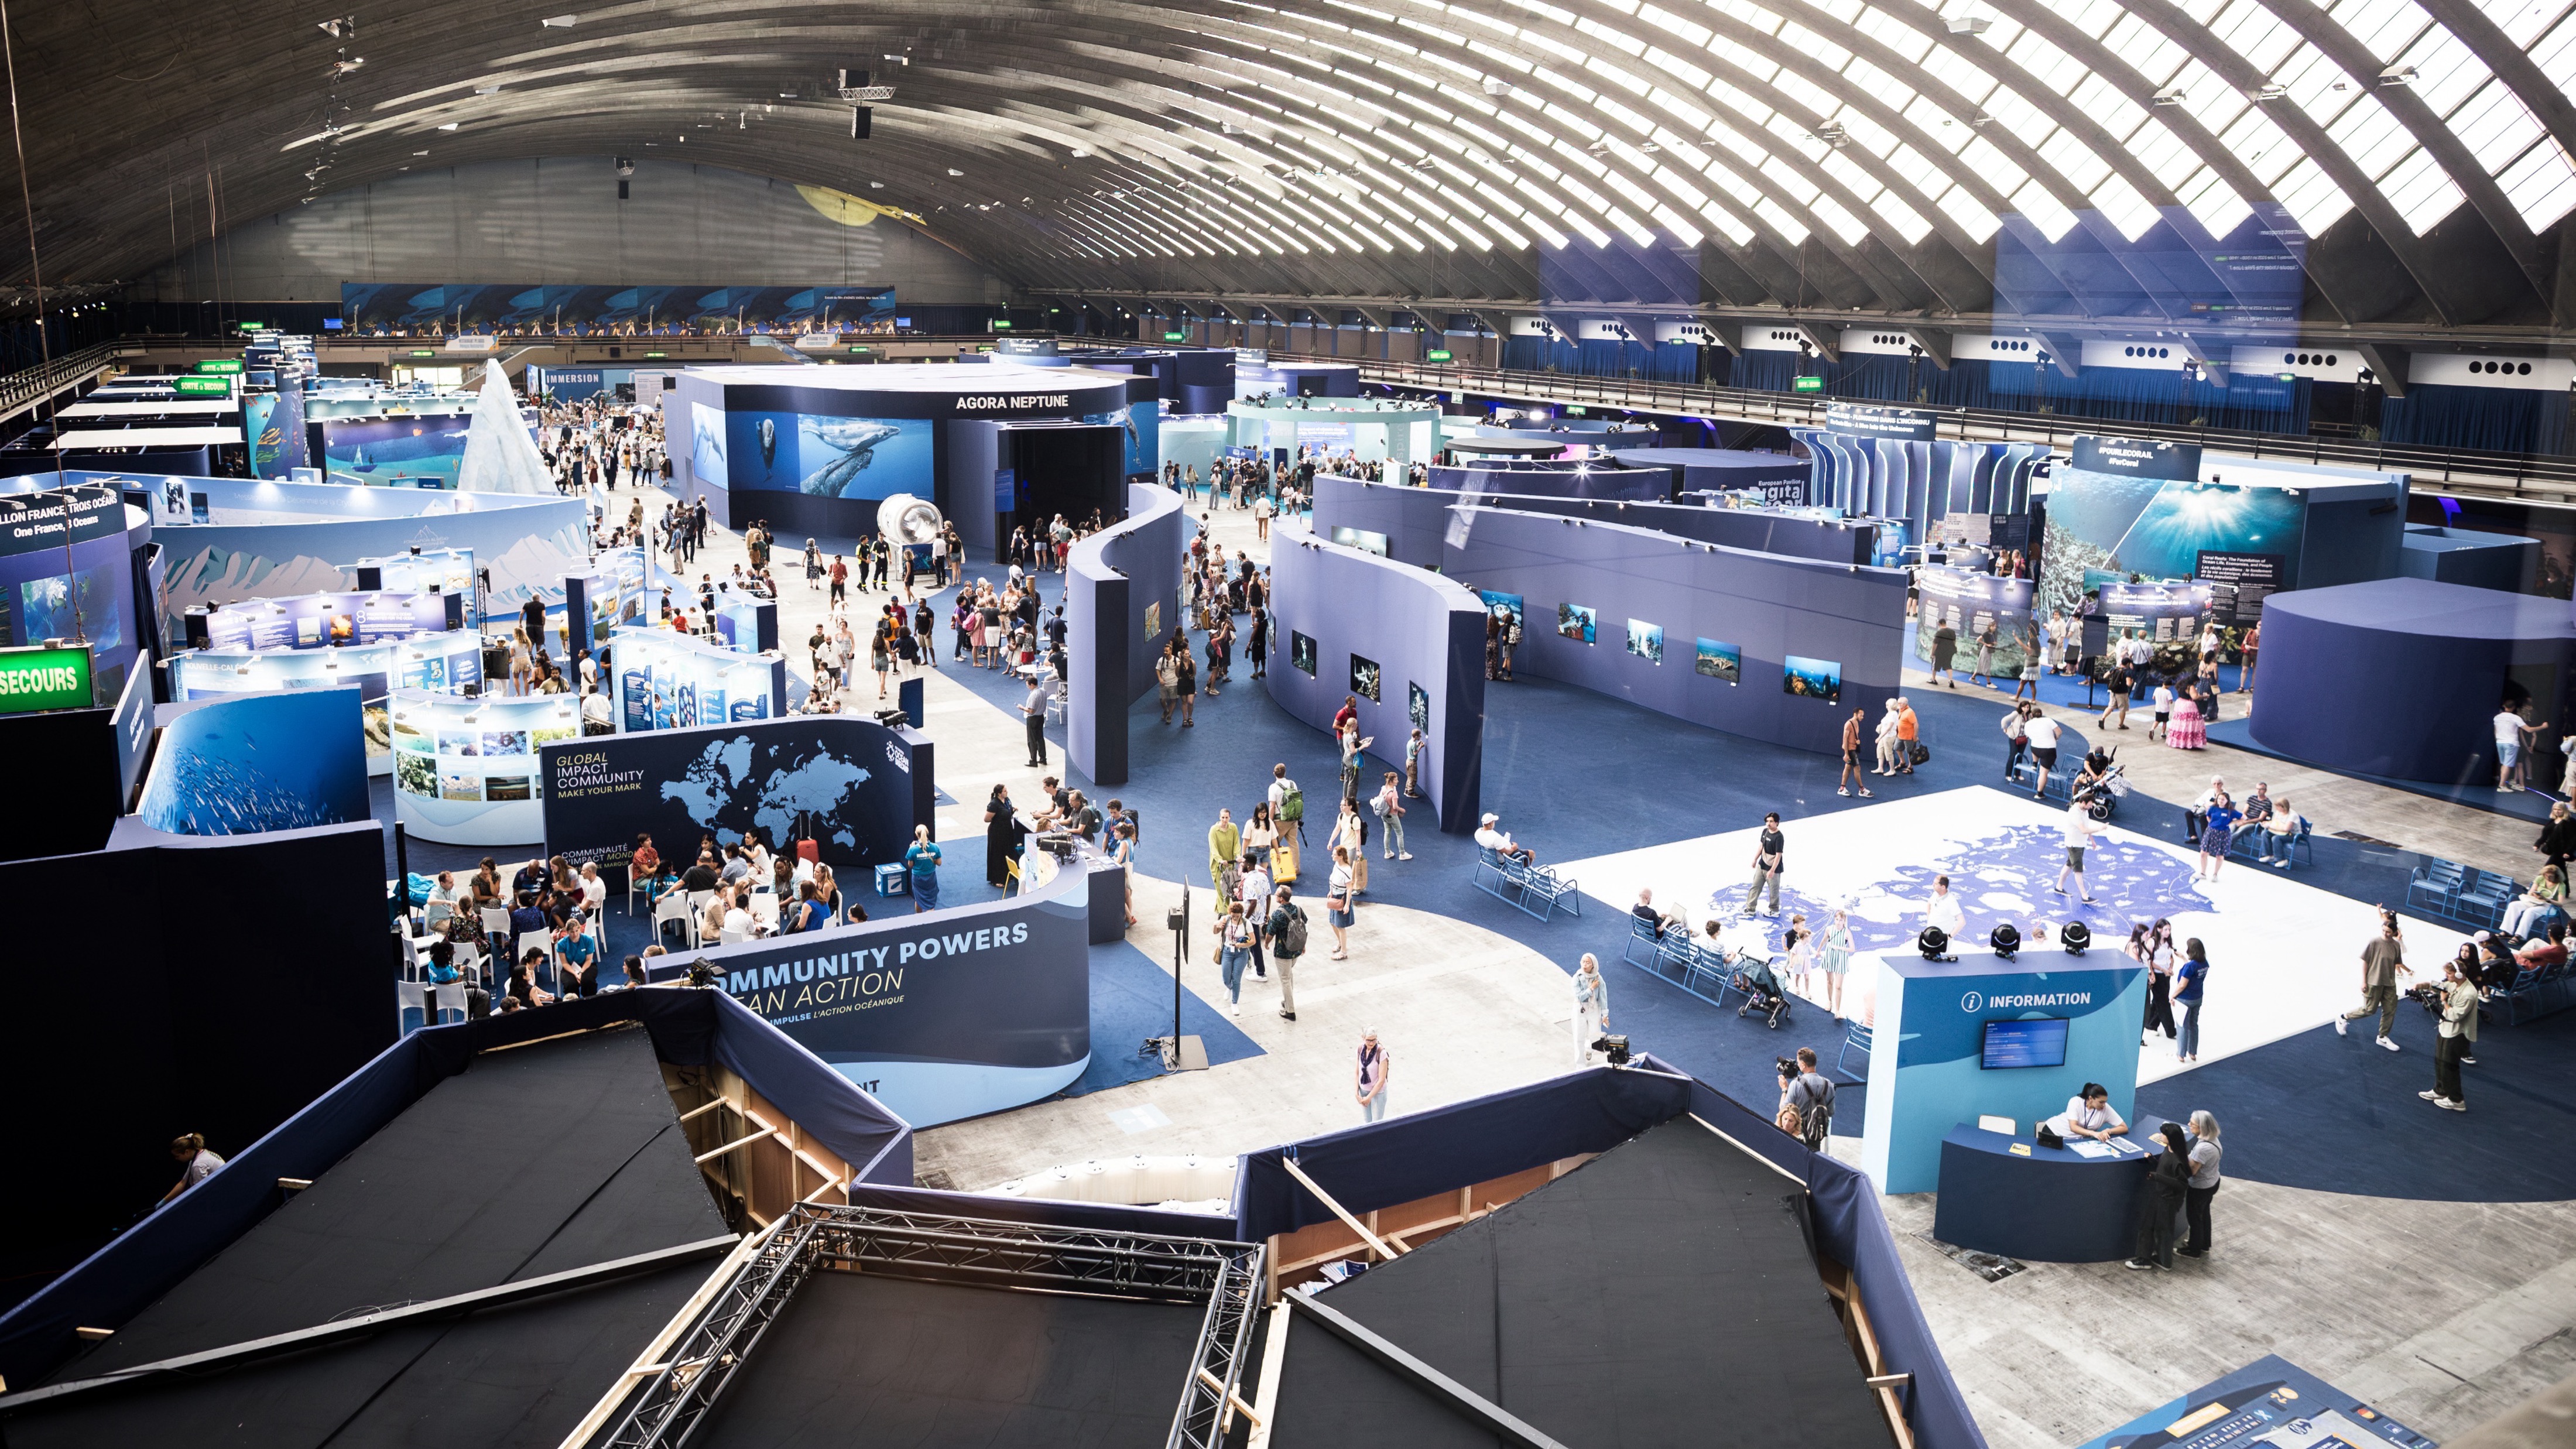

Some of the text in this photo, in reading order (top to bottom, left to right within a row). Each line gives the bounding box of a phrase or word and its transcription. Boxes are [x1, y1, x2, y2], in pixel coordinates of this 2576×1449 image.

[181, 382, 198, 390] SORTIE
[204, 382, 227, 390] SECOURS
[546, 374, 599, 383] IMMERSION
[956, 395, 1068, 409] AGORA NEPTUNE
[2098, 447, 2153, 459] #POURLECORAIL
[28, 505, 67, 521] FRANCE,
[68, 501, 91, 514] TROIS
[93, 494, 117, 508] OCÉANS
[14, 527, 33, 538] One
[34, 522, 66, 535] France,
[73, 515, 98, 527] Oceans
[357, 610, 366, 624] 8
[0, 667, 77, 695] SECOURS
[557, 752, 608, 766] GLOBAL
[557, 763, 608, 777] IMPACT
[558, 770, 644, 789] COMMUNITY
[559, 783, 641, 799] MAKE YOUR MARK
[561, 842, 628, 859] COMMUNAUTÉ
[607, 850, 636, 861] MOND
[711, 922, 1028, 994] OMMUNITY POWERS
[794, 968, 903, 1008] ACTION
[1989, 992, 2091, 1008] INFORMATION
[769, 995, 905, 1026] IMPULSE L'ACTION OCÉANIQUE
